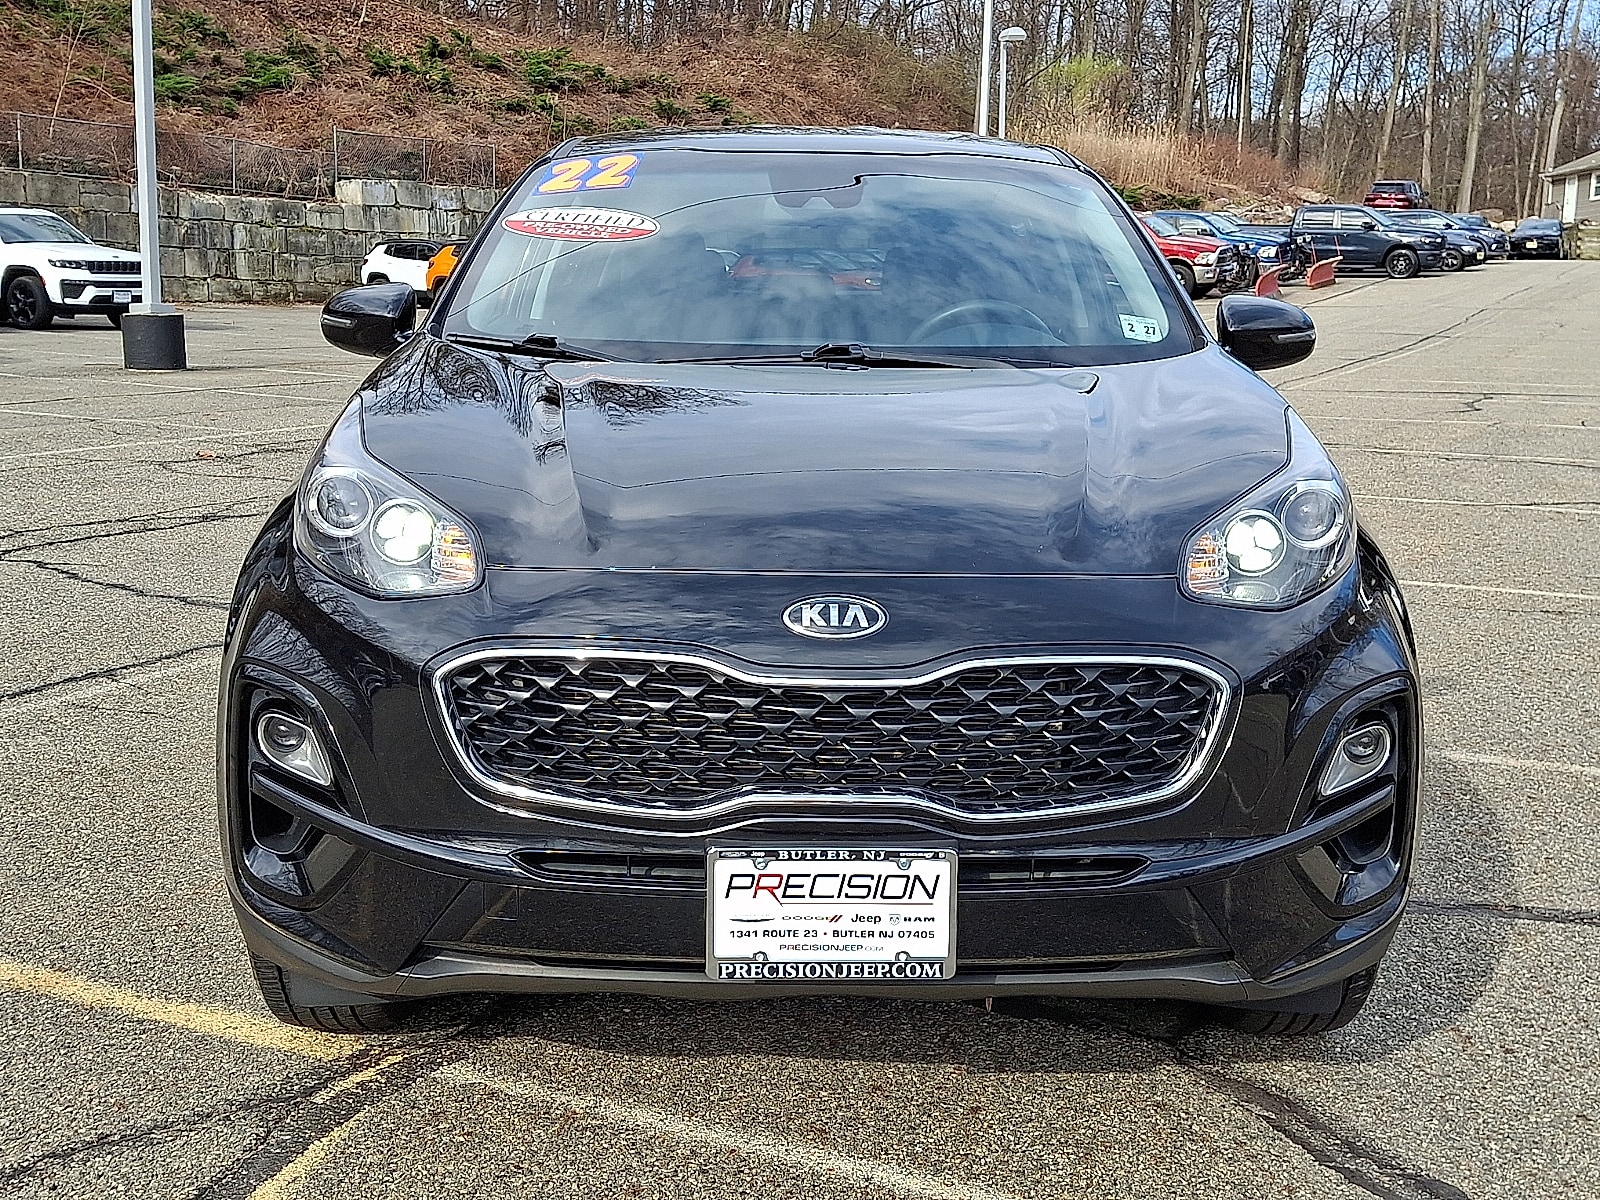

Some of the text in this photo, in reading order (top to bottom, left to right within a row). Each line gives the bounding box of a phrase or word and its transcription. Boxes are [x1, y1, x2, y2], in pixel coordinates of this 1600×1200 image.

[537, 154, 640, 192] 22
[526, 211, 645, 228] CERTIFIED
[521, 221, 632, 234] PRE-OWNED
[535, 227, 612, 238] VEHICLE
[1127, 322, 1156, 336] 2 27
[800, 603, 869, 628] KIA
[778, 850, 857, 860] BUTLER,
[863, 850, 886, 860] NJ
[725, 873, 940, 907] PRECISION
[851, 913, 882, 925] Jeep
[730, 929, 935, 939] 1341 ROUTE 23 BUTLER NJ 07405
[779, 944, 884, 952] PRECISIONJEEPCOM
[719, 963, 943, 979] PRECISIONJEEP.COM
